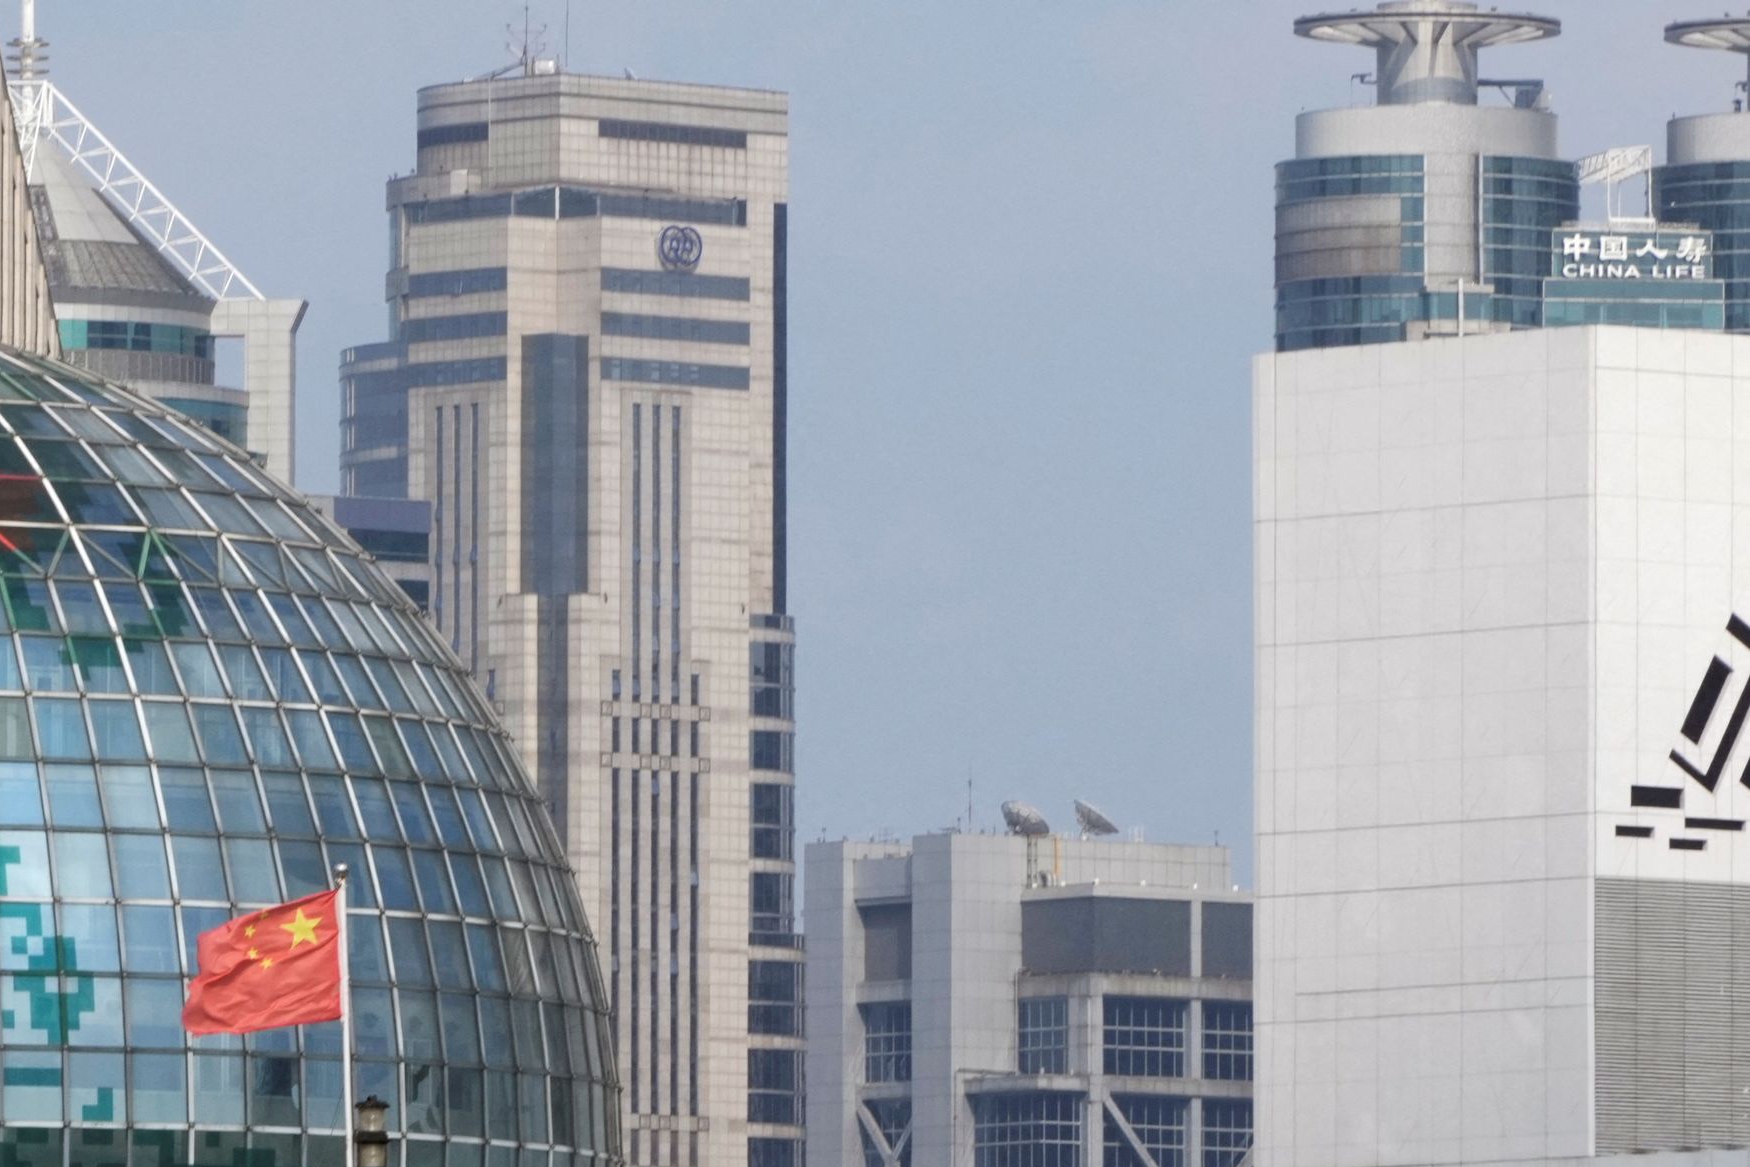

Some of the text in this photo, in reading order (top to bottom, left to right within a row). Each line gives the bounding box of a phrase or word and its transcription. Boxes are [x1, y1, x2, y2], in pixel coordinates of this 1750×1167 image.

[1562, 233, 1707, 263] 中国人寿
[1562, 263, 1705, 278] CHINA LIFE
